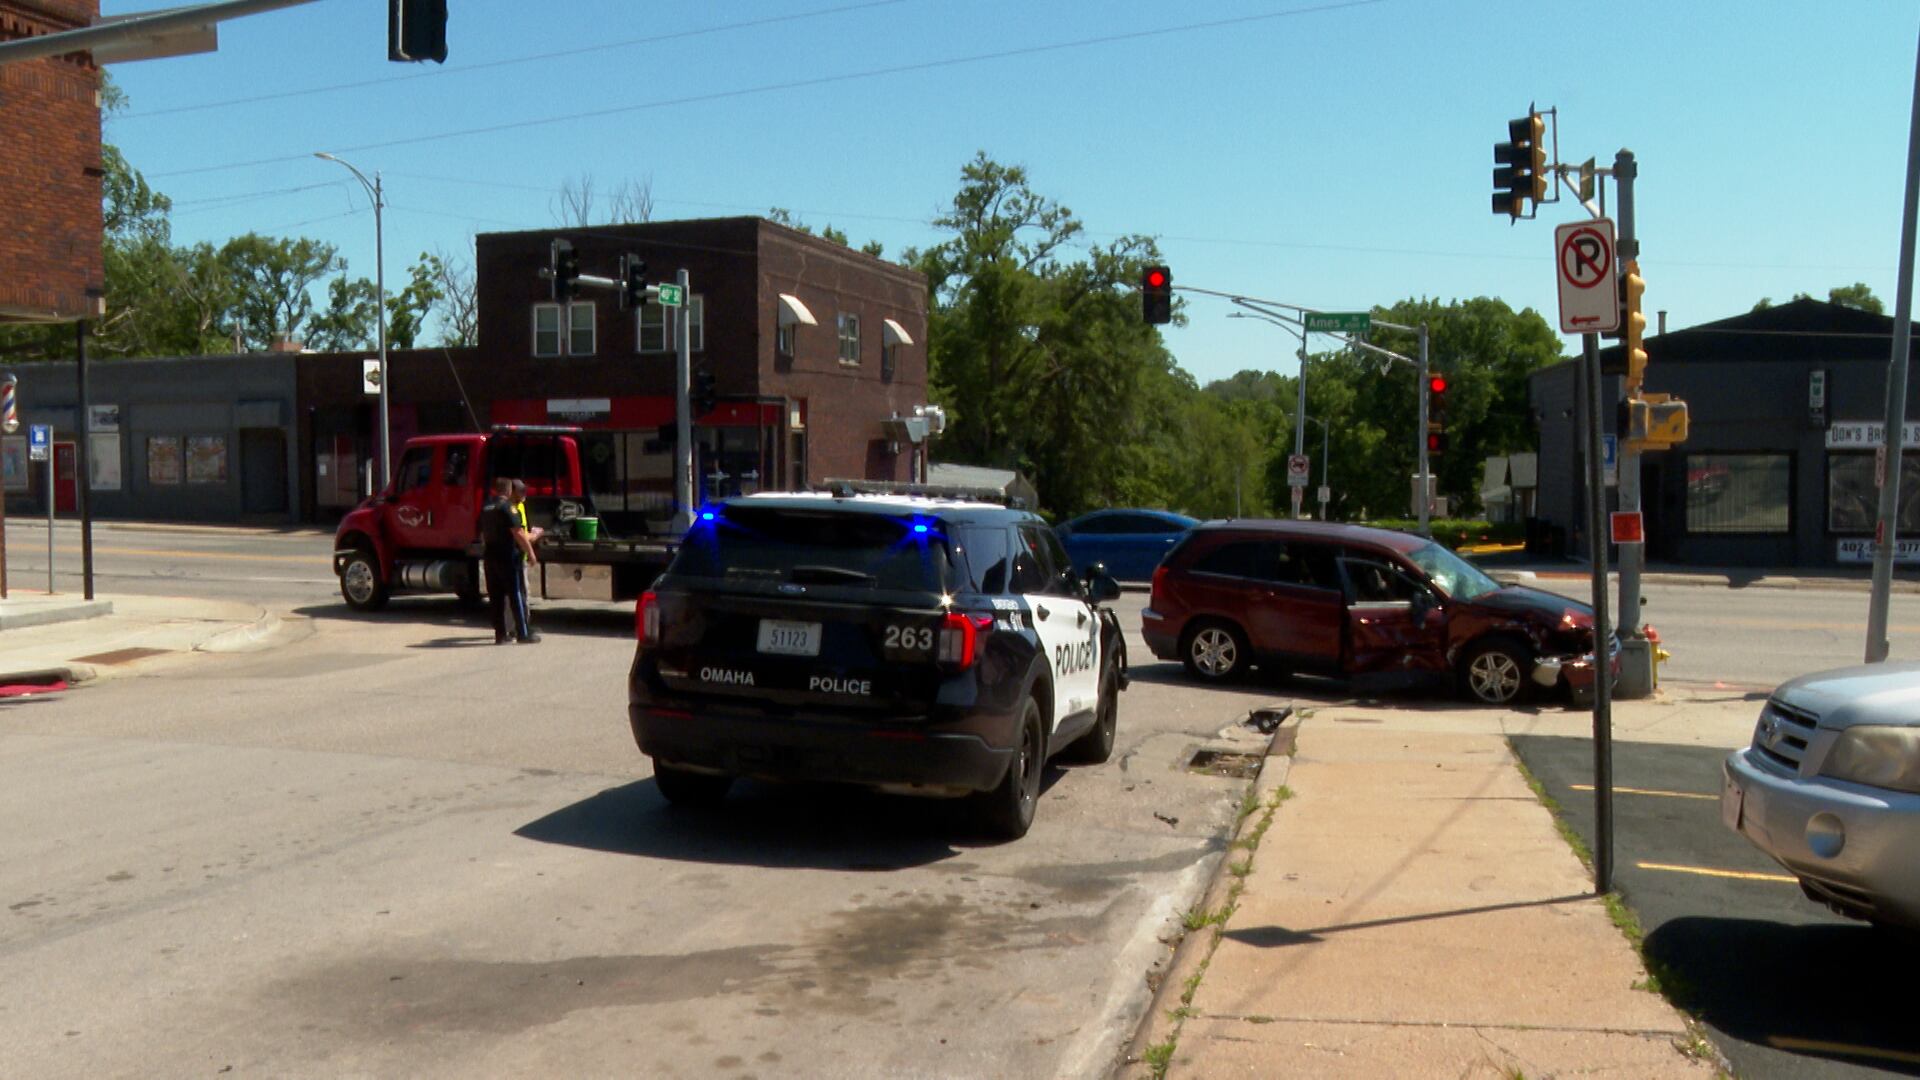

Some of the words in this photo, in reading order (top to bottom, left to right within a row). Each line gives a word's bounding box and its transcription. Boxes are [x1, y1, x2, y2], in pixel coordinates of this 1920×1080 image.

[1309, 317, 1340, 329] Ames
[771, 630, 808, 647] 51123
[884, 625, 934, 650] 263
[1056, 641, 1091, 676] POLICE
[700, 667, 755, 686] OMAHA
[809, 677, 871, 695] POLICE
